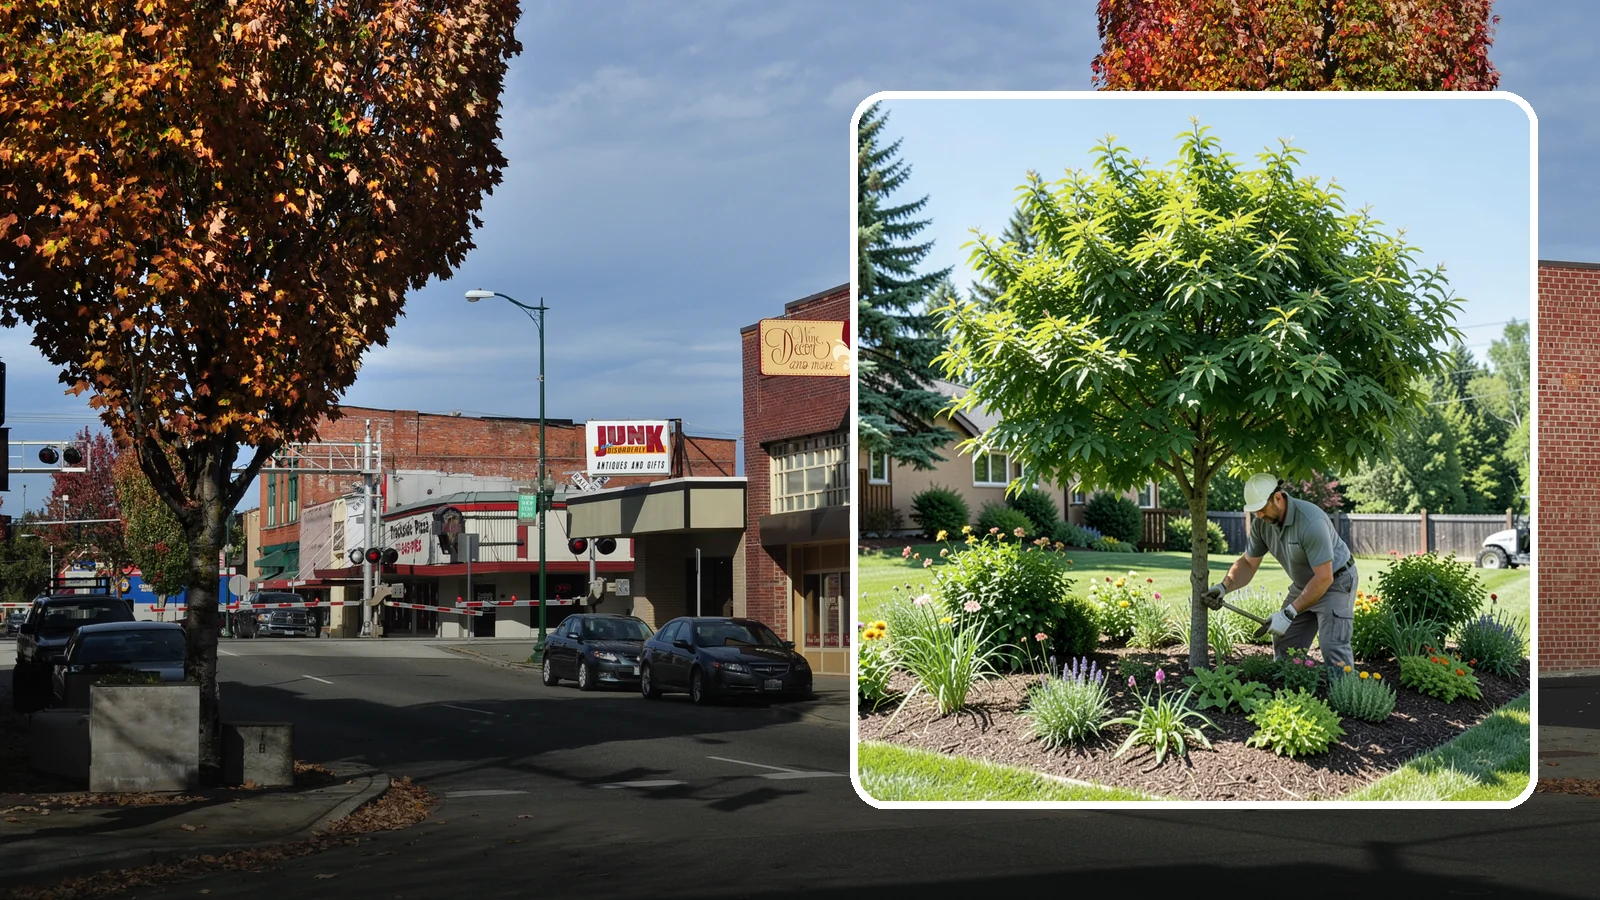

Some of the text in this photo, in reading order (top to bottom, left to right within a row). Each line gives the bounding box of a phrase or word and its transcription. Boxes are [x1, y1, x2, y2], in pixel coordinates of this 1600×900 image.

[595, 425, 665, 457] JUNK
[607, 446, 646, 454] DISORDERLY
[596, 460, 665, 470] ANTIQUES AND GIFTS
[414, 519, 429, 535] Pizza
